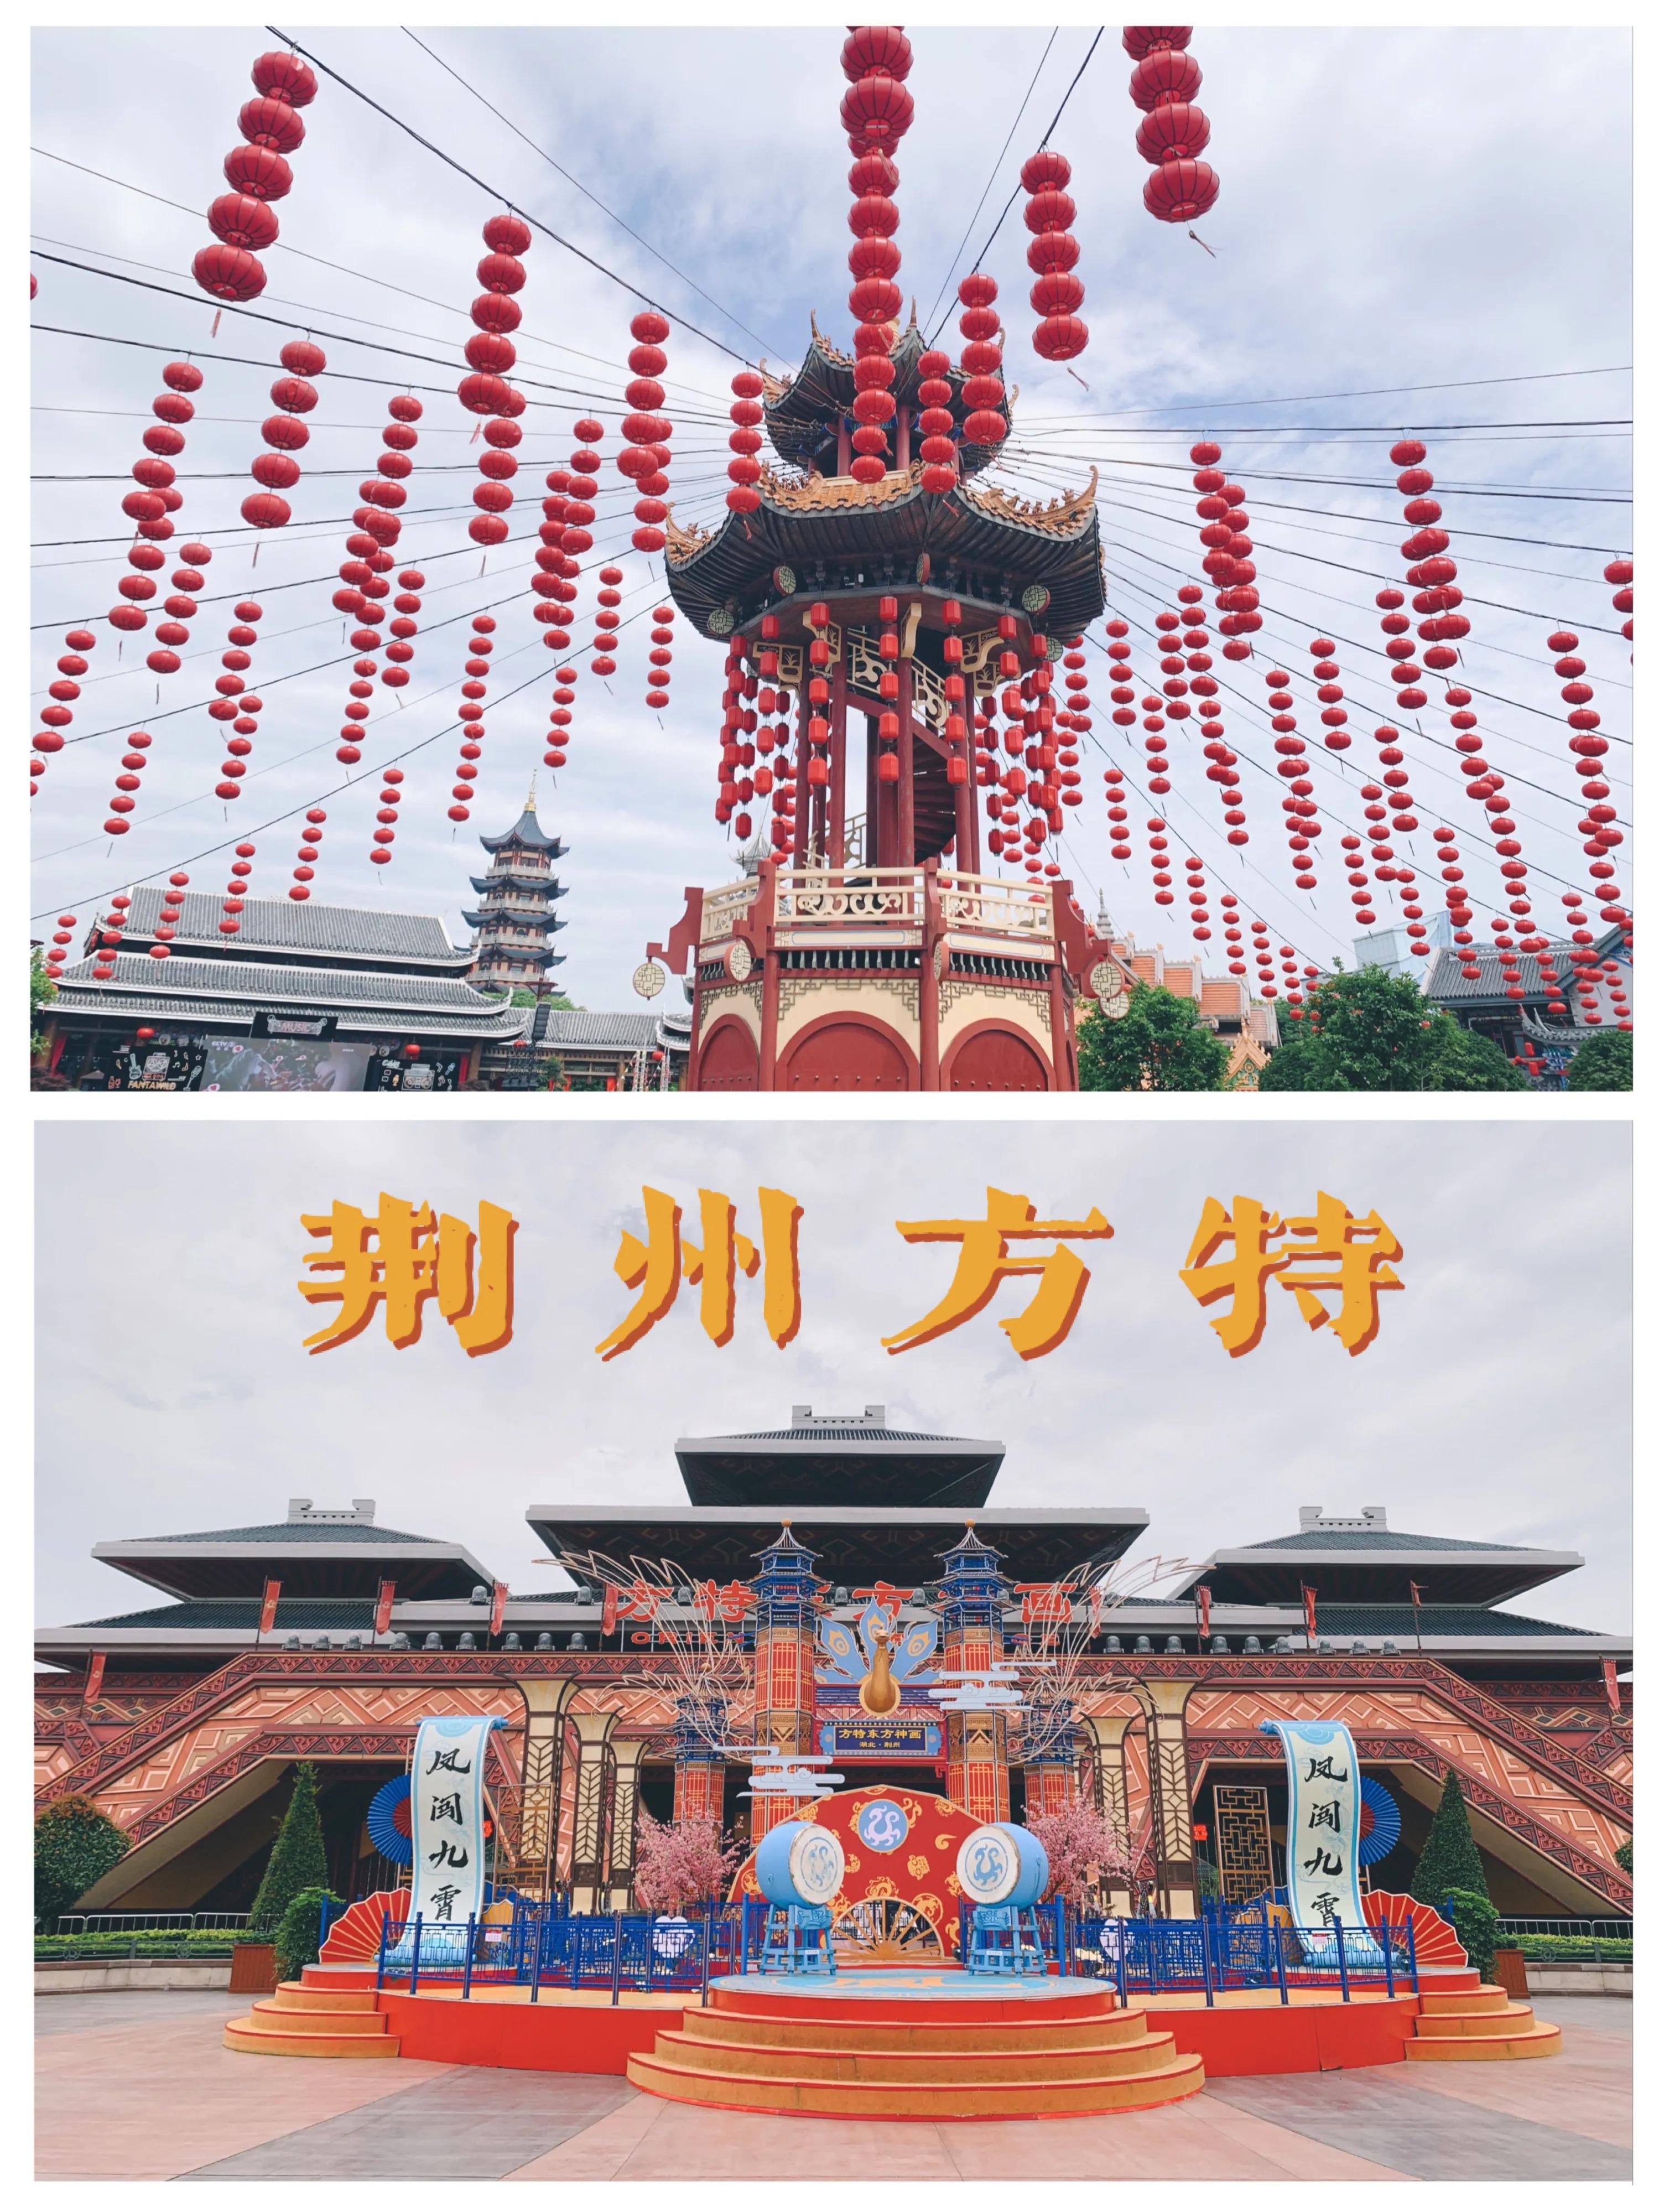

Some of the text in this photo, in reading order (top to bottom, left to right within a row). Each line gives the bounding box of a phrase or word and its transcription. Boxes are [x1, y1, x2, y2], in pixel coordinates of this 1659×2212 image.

[281, 1022, 310, 1032] MUSIC
[128, 1081, 176, 1090] FANTAWILD
[839, 1728, 922, 1740] 方特东方神画
